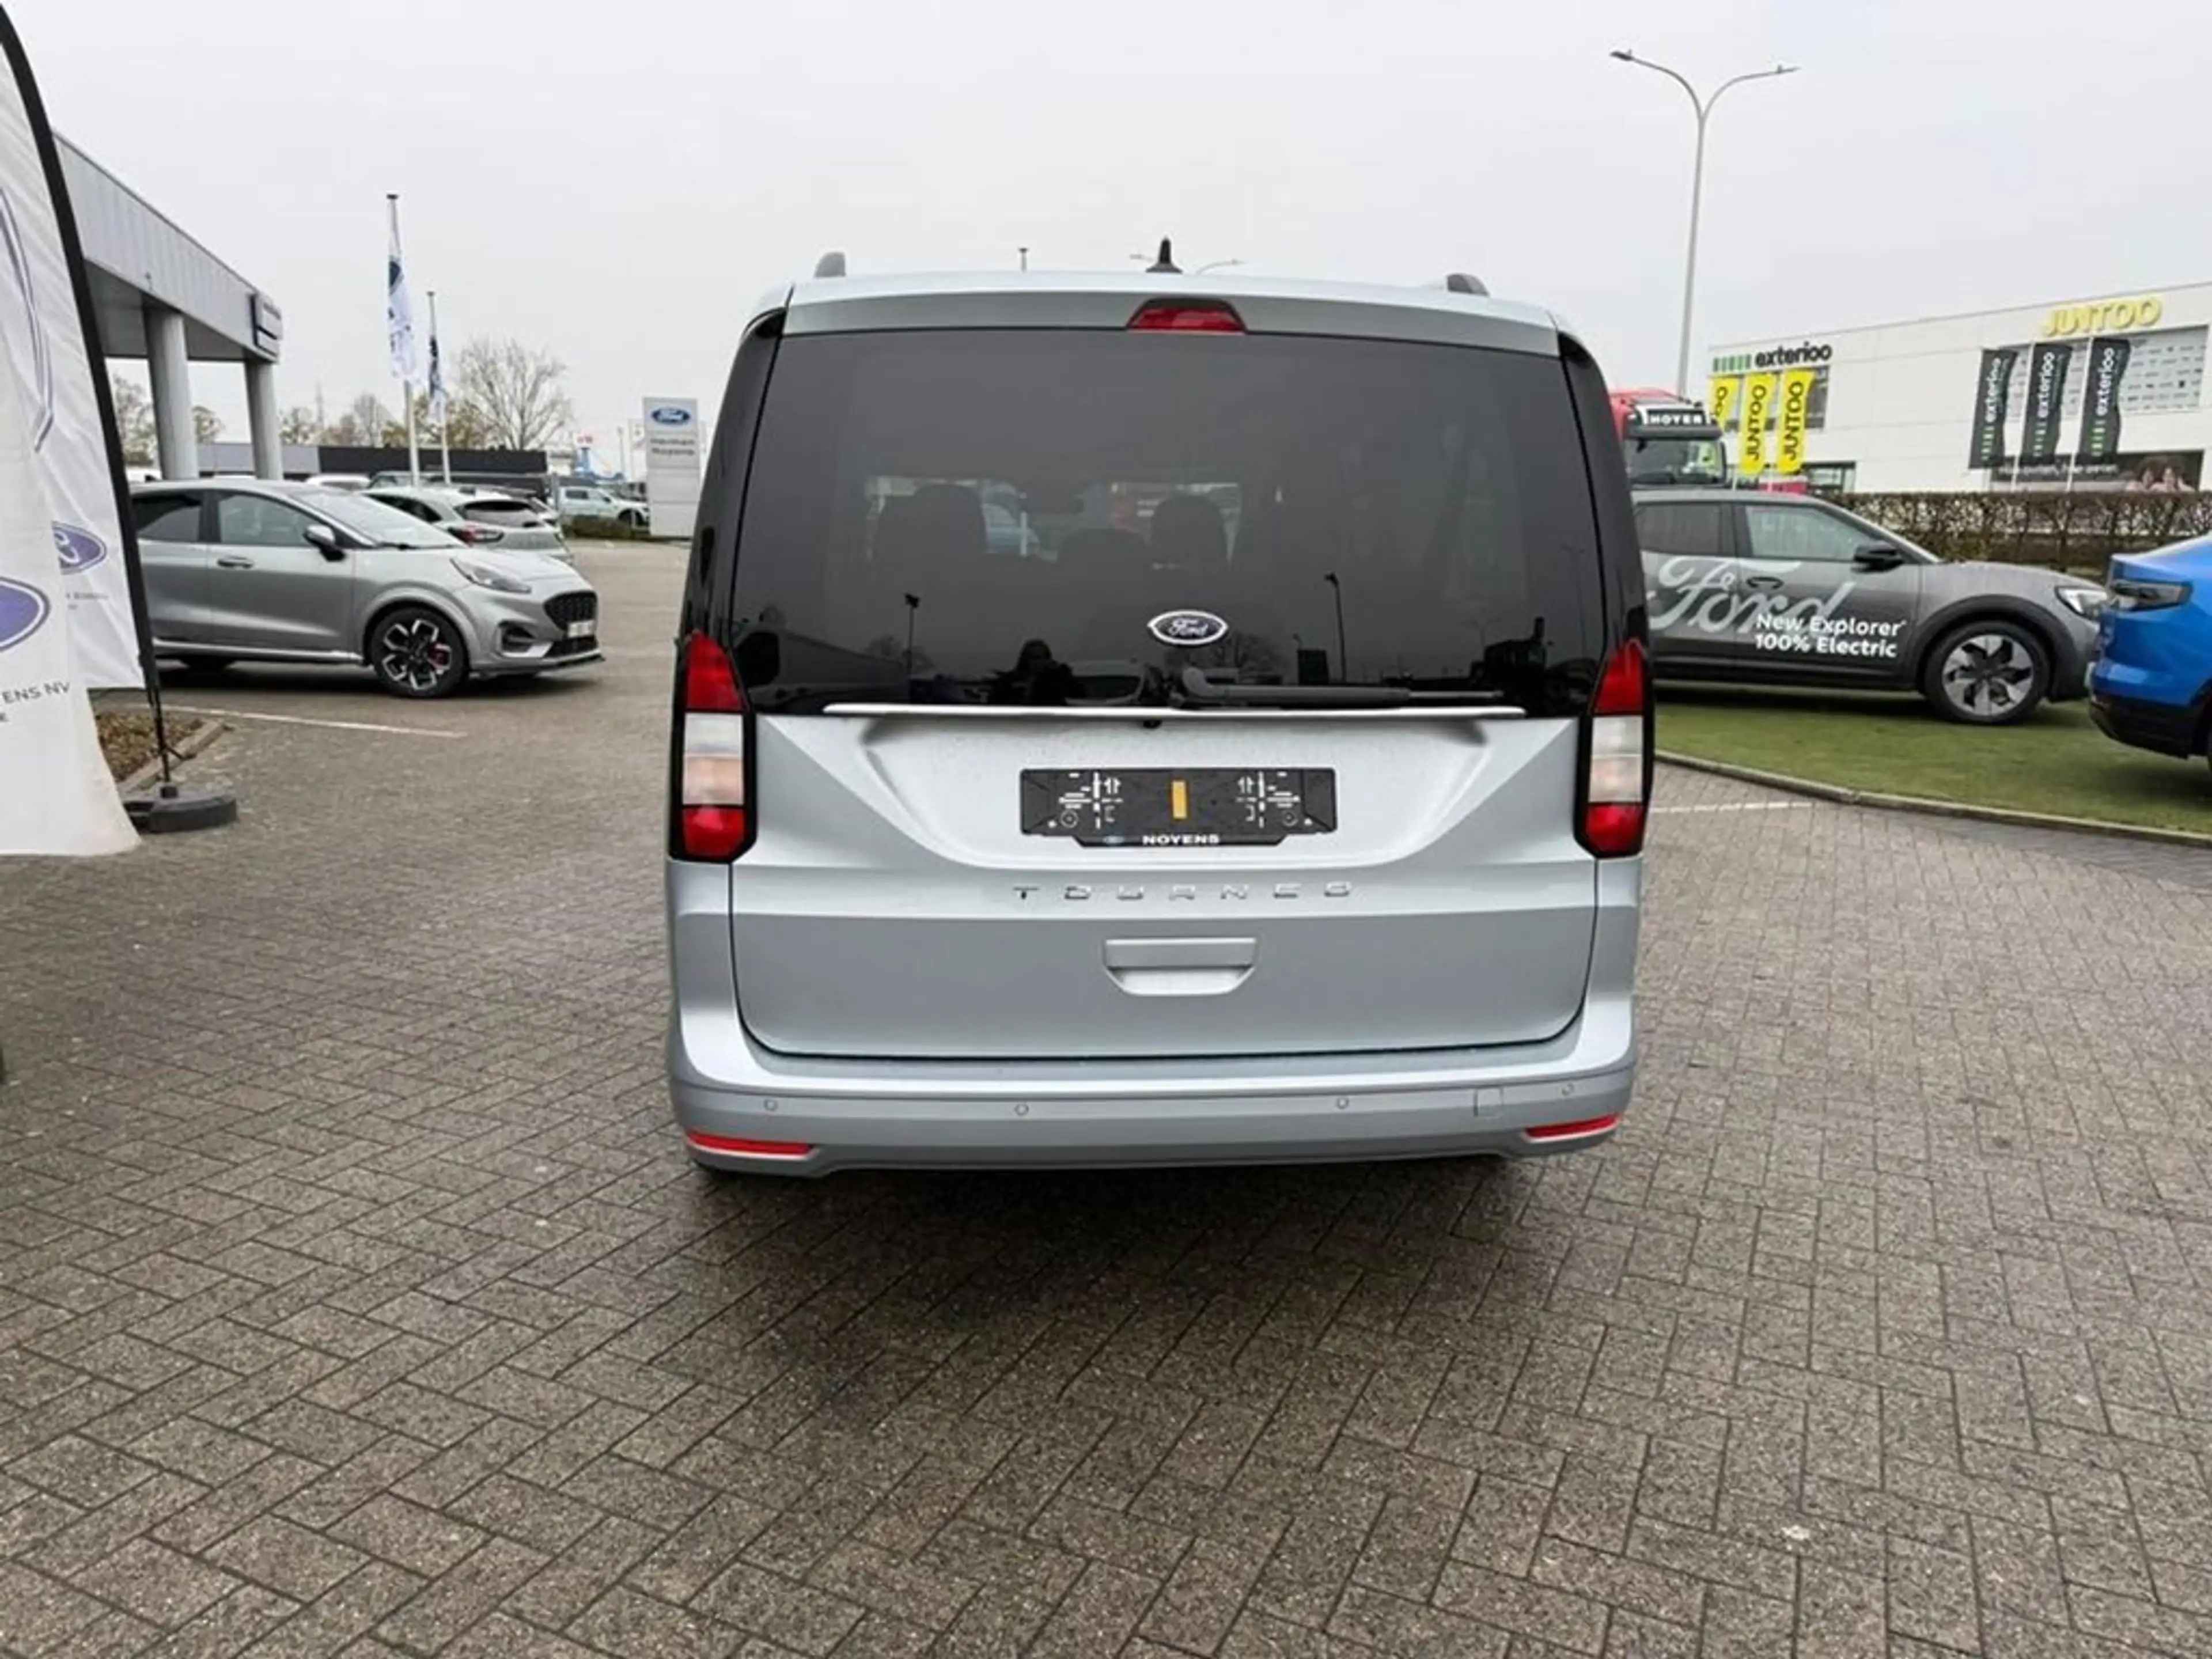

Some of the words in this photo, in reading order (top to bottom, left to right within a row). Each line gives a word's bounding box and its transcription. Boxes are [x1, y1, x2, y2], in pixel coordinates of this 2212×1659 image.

[2042, 298, 2163, 336] JUNTOO
[1755, 340, 1832, 368] exterioo
[2037, 351, 2055, 418] exterioo
[2095, 347, 2115, 416] exterioo
[1747, 384, 1766, 461] JUNTOO
[1784, 381, 1804, 461] JUNTOO
[1647, 555, 1857, 634] Ford
[1168, 618, 1209, 636] Ford
[1756, 613, 1804, 631] New
[1755, 634, 1810, 651] 100%
[1817, 639, 1897, 658] Electric
[44, 682, 70, 694] NV
[1142, 834, 1220, 846] NOYENS
[1013, 882, 1351, 901] TOURNEO
